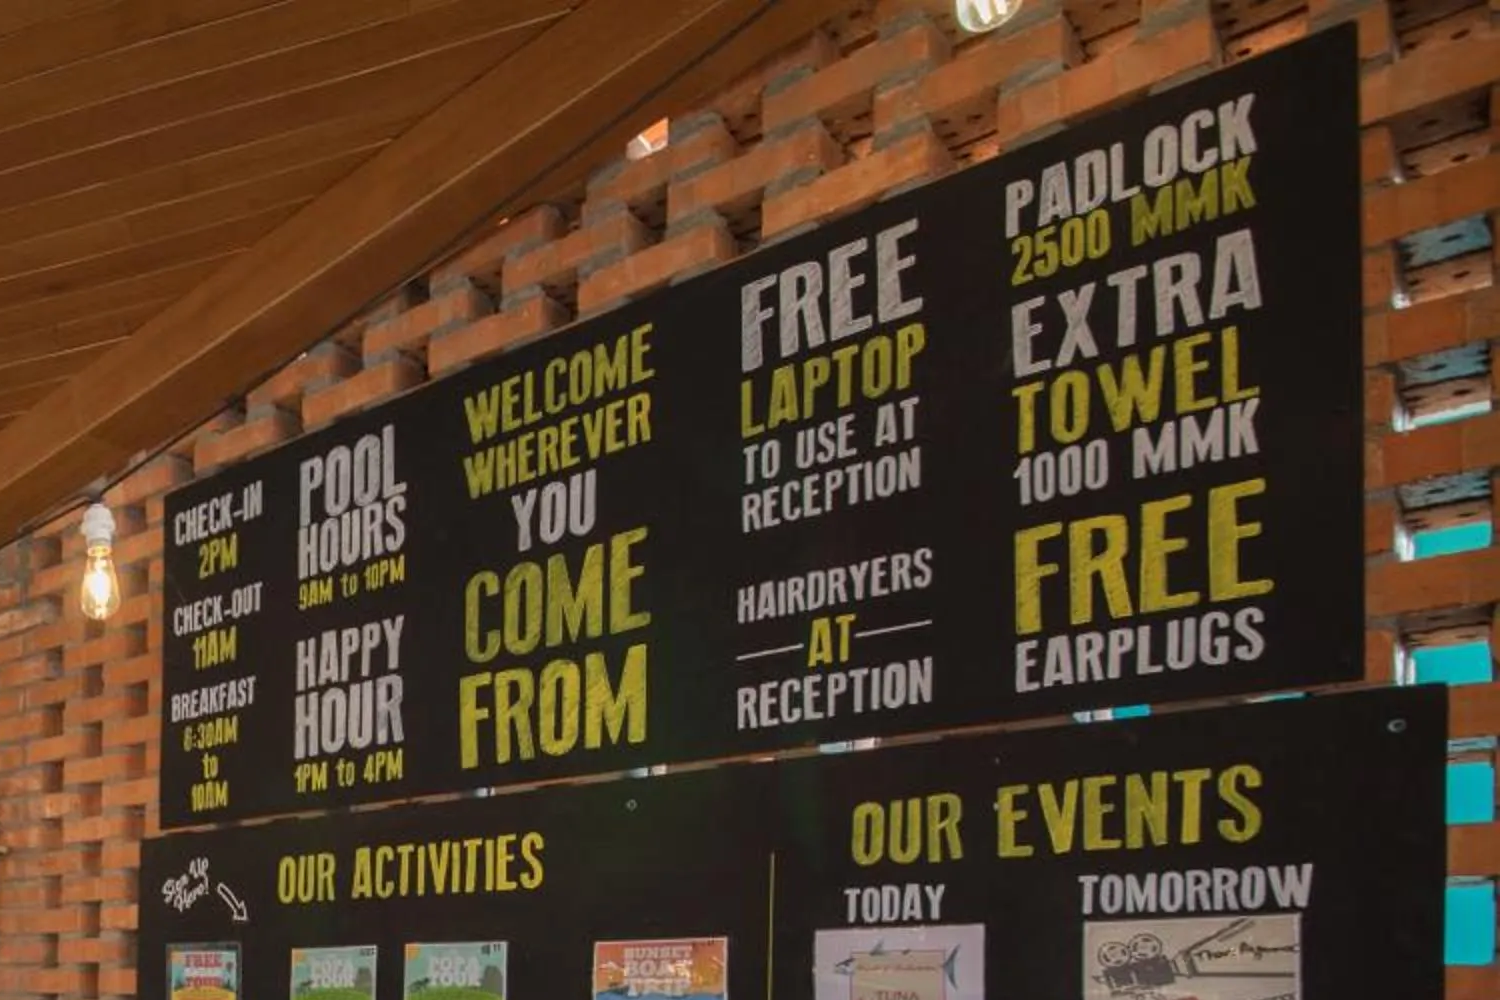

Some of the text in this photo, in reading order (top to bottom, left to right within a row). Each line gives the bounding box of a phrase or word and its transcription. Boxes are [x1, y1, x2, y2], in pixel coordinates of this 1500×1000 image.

[1005, 93, 1258, 240] PADLOCK
[1011, 155, 1257, 287] 2500 MMK
[741, 218, 923, 374] FREE
[1011, 228, 1262, 379] EXTRA
[464, 322, 655, 445] WELCOME
[741, 323, 926, 439] LAPTOP
[1012, 325, 1260, 455] TOWEL
[302, 423, 407, 526] POOL
[464, 392, 651, 499] WHEREVER
[742, 397, 919, 484] TO USE AT
[1013, 397, 1261, 506] 1000 MMK
[175, 480, 263, 547] CHECK-IN
[511, 469, 598, 552] YOU
[742, 447, 921, 533] RECEPTION
[199, 533, 237, 579] 2PM
[298, 494, 406, 579] HOURS
[1014, 477, 1274, 636] FREE
[174, 582, 263, 637] CHECK-OUT
[299, 555, 405, 609] 9AM to 10PM
[463, 527, 651, 664] COME
[737, 548, 933, 625] HAIRDRYERS
[192, 627, 237, 671] 11AM
[296, 615, 405, 691] HAPPY
[808, 613, 857, 667] AT
[1015, 606, 1265, 694] EARPLUGS
[171, 676, 256, 723] BREAKFAST
[294, 674, 404, 759] HOUR
[458, 643, 648, 770] FROM
[737, 656, 933, 730] RECEPTION
[191, 780, 228, 812] 10AM
[202, 752, 218, 778] to
[294, 748, 404, 793] 1PM to 4PM
[851, 764, 1264, 866] OUR EVENTS
[278, 832, 545, 904] OUR ACTIVITIES
[844, 884, 945, 924] TODAY
[1078, 863, 1314, 915] TOMORROW
